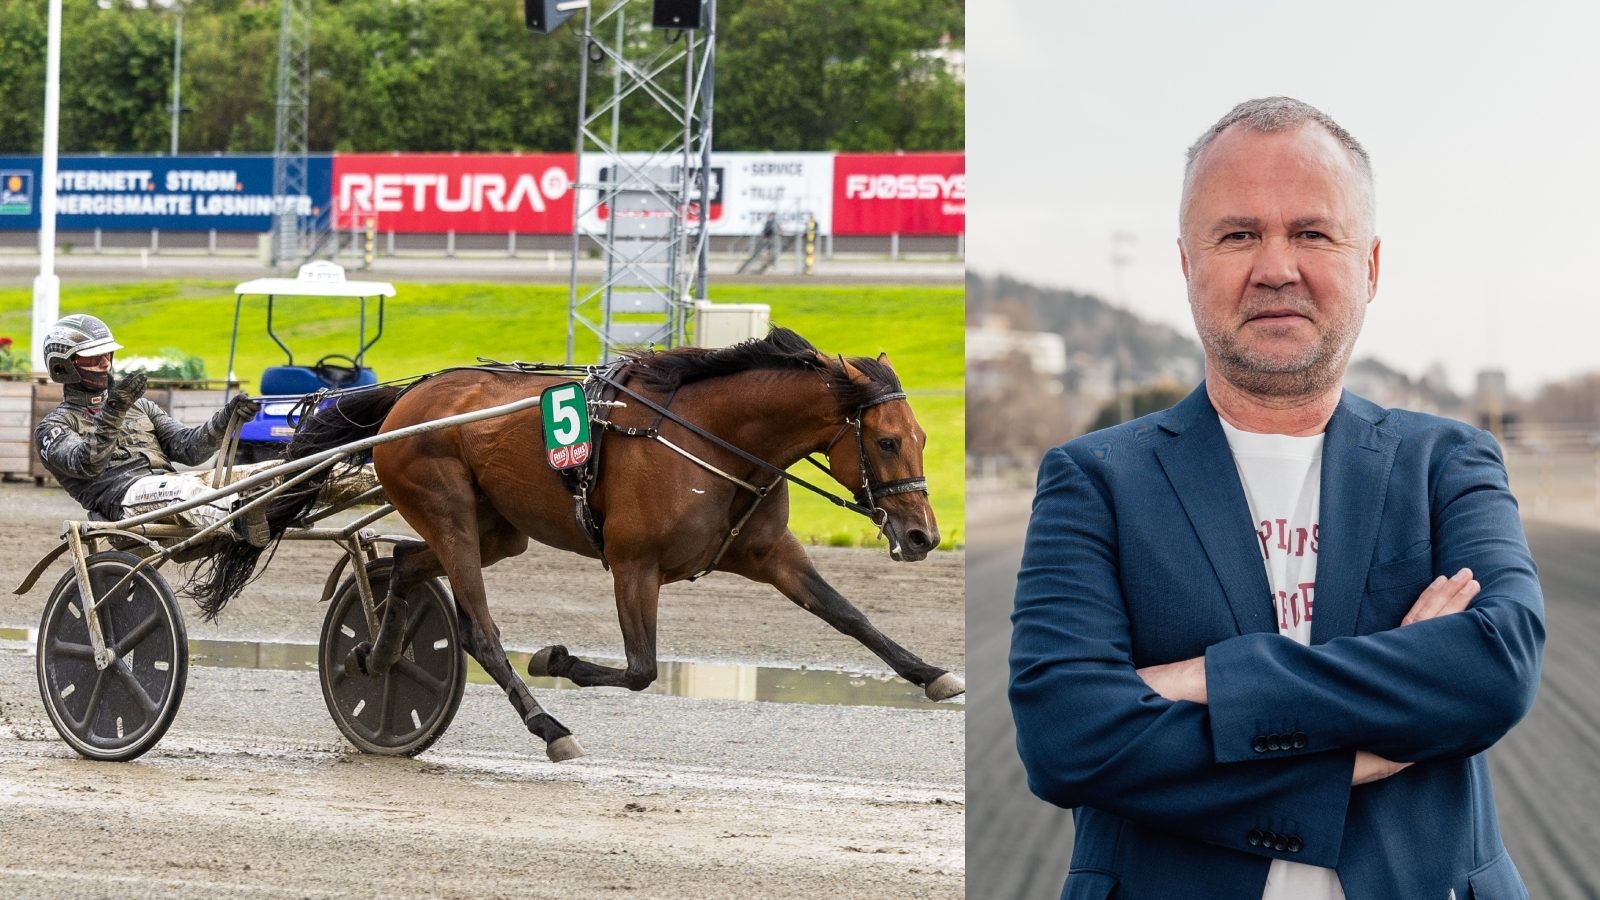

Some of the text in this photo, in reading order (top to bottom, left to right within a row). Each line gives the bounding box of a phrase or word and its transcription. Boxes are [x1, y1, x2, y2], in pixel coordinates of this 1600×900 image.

[55, 194, 192, 216] NERGISMARTE
[339, 174, 546, 212] RETURA
[551, 387, 580, 445] 5
